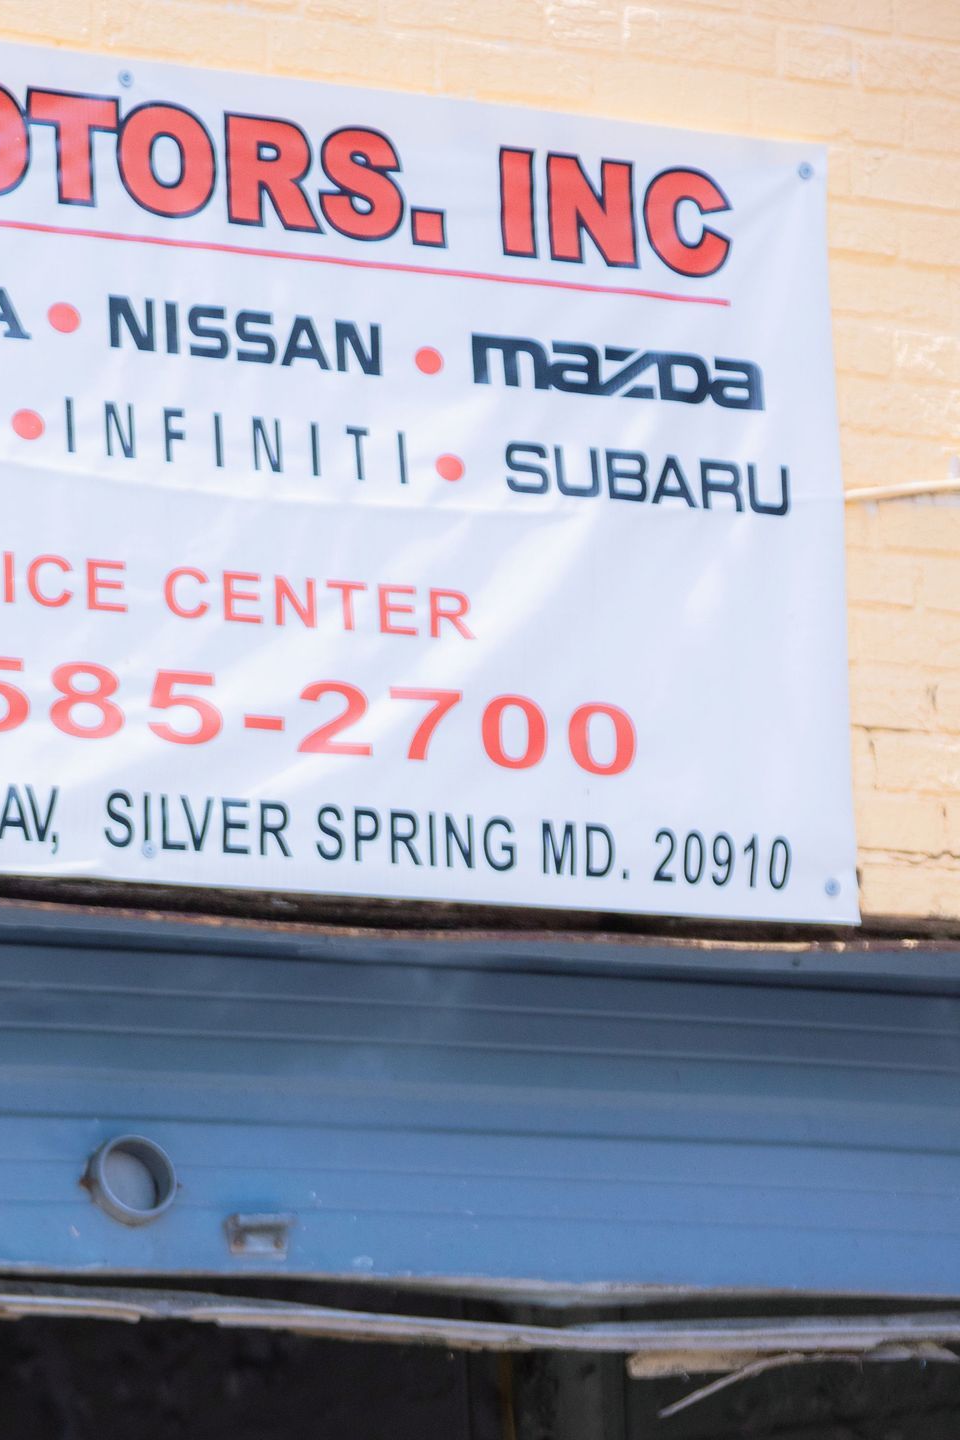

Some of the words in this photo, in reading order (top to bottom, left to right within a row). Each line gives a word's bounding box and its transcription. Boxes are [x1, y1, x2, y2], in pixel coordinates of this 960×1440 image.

[498, 146, 734, 278] INC
[108, 294, 383, 376] NISSAN
[66, 397, 410, 486] INFINITI
[505, 442, 791, 517] SUBARU
[164, 566, 476, 640] CENTER
[104, 789, 293, 860] SILVER
[316, 803, 517, 873] SPRING
[541, 822, 630, 881] MD.
[652, 828, 792, 891] 20910
